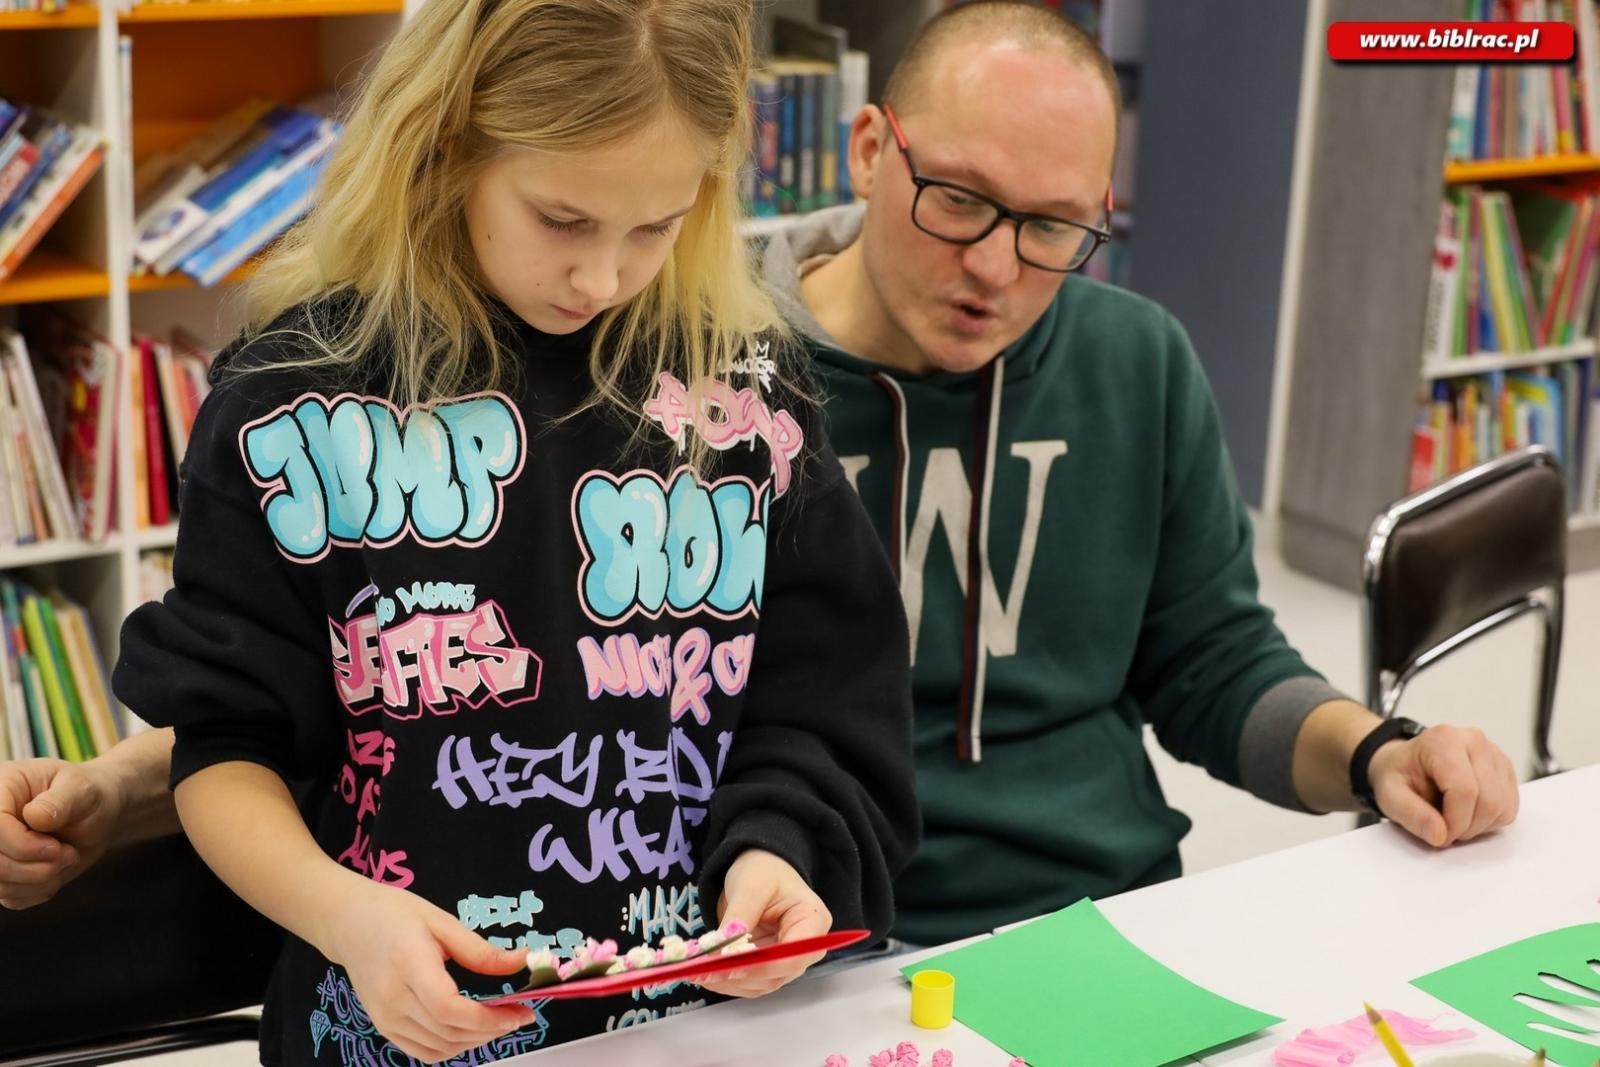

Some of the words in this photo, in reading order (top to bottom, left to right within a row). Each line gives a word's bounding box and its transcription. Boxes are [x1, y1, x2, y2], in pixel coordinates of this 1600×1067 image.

[239, 391, 527, 564] JUMP
[432, 731, 604, 810] HEY
[628, 882, 706, 943] MAKE
